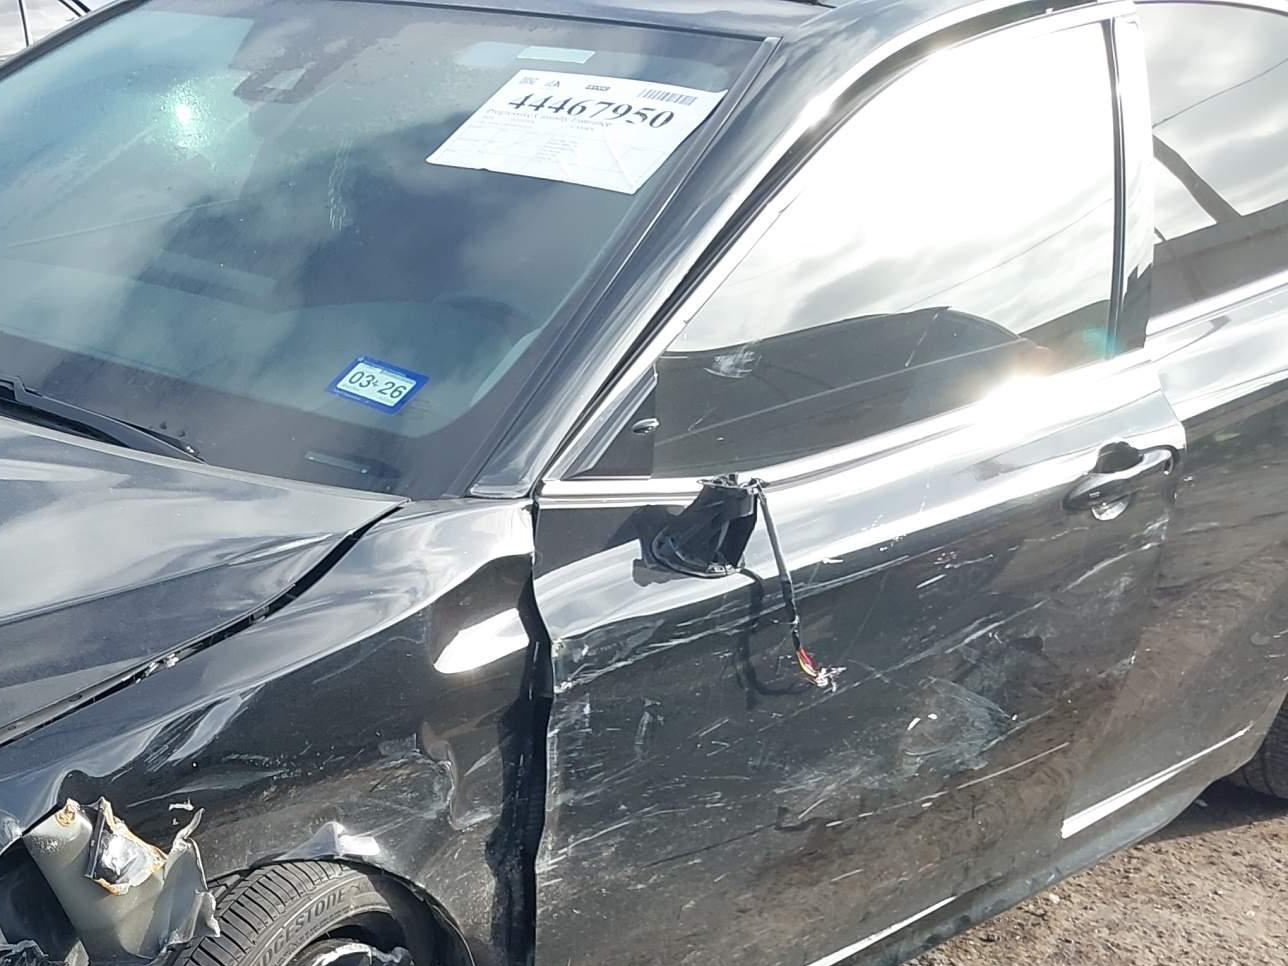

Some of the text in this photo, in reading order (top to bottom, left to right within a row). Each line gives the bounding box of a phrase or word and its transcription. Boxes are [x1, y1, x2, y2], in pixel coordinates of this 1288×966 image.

[508, 93, 675, 129] 44467950
[348, 371, 407, 399] 03 26
